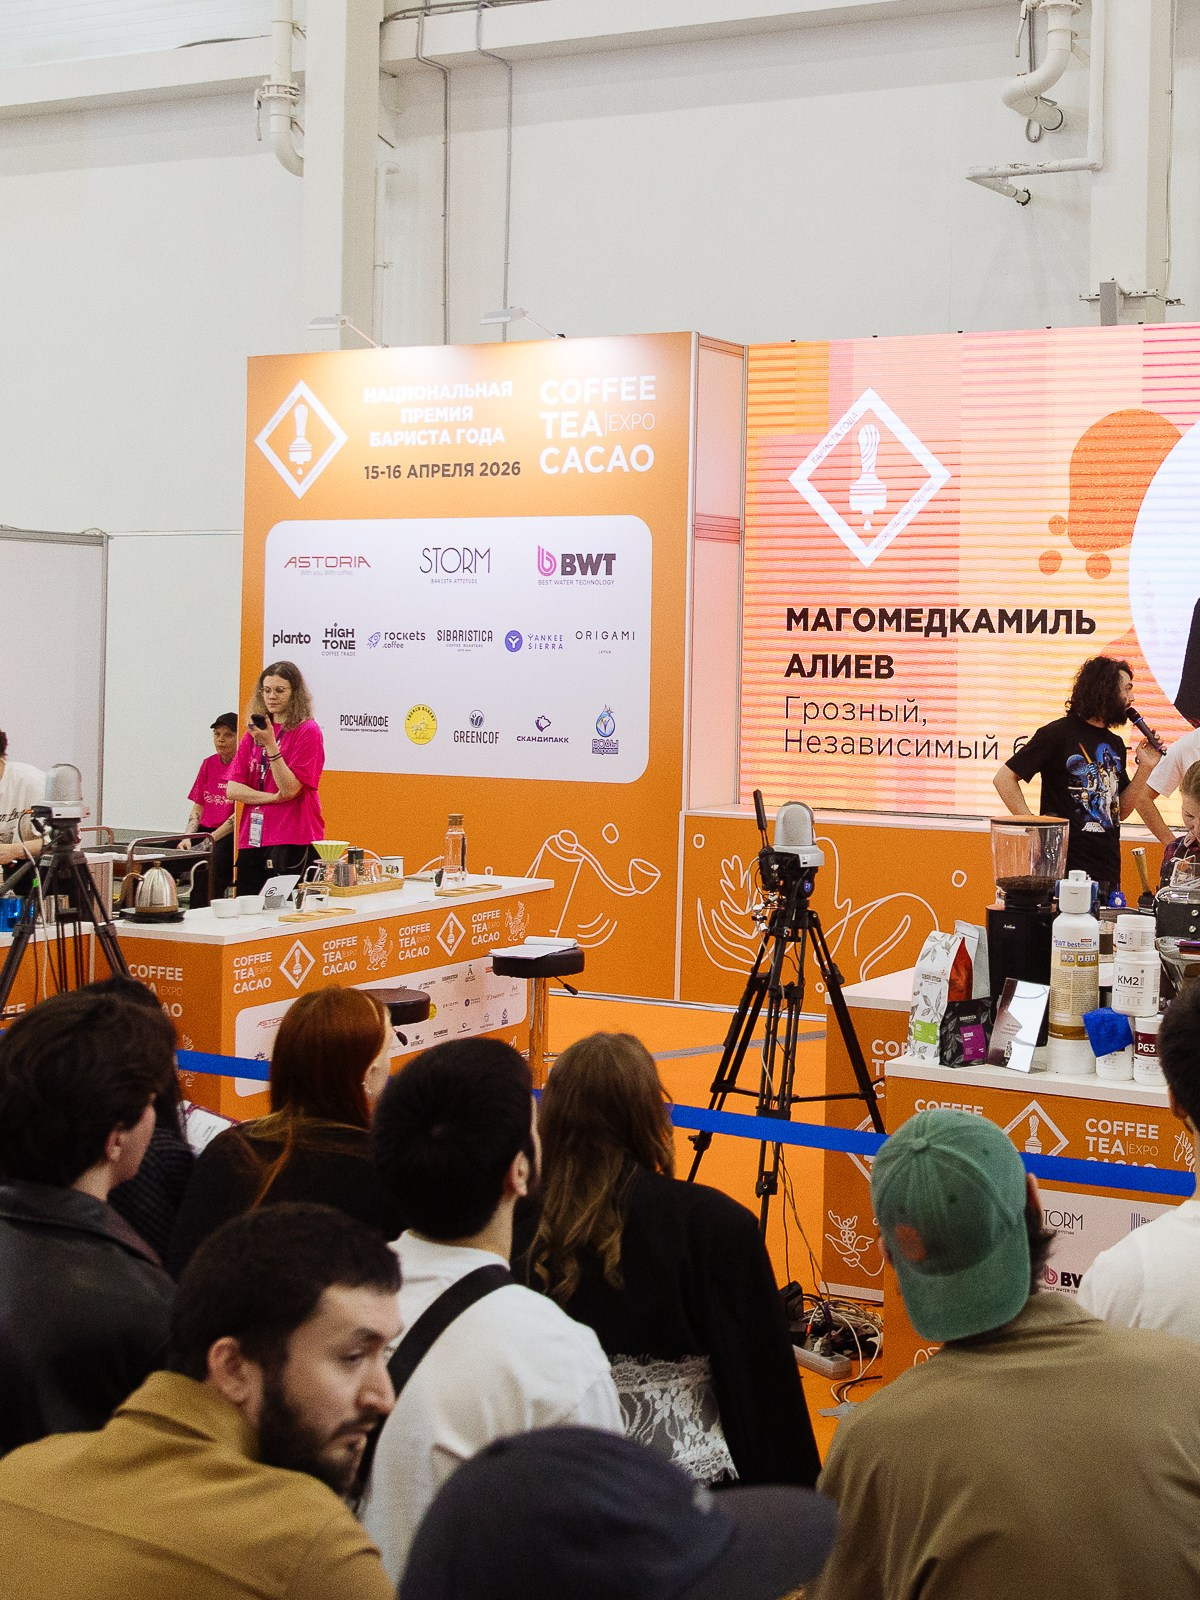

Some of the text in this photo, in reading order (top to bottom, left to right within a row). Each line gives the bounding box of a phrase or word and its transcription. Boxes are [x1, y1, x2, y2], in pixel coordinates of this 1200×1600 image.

[364, 381, 513, 403] НАЦИОНАЛЬНАЯ
[540, 376, 656, 405] COFFEE
[402, 406, 474, 423] ПРЕМИЯ
[540, 411, 656, 439] TEA EXPO
[369, 427, 505, 447] БАРИСТА ГОДА
[539, 444, 656, 475] CACAO
[364, 461, 521, 480] 15-16 АПРЕЛЯ 2026
[284, 556, 372, 569] ASTORIA
[419, 547, 491, 574] STORM
[561, 553, 616, 576] BWT
[786, 607, 1097, 637] МАГОМЕДКАМИЛЬ
[272, 629, 312, 647] planto
[384, 631, 426, 641] rockets
[436, 629, 493, 642] SIBARISTICA
[528, 633, 563, 642] YANKEE
[575, 631, 636, 641] ORIGAMI
[322, 640, 356, 650] TONE
[528, 642, 564, 650] SIERRA
[784, 654, 896, 679] АЛИЕВ
[785, 696, 928, 727] Грозный,
[340, 713, 389, 727] РОСЧАЙКОФЕ
[453, 730, 500, 744] GREENCOF
[516, 735, 569, 744] СКАНДИПАКК
[785, 728, 999, 760] Независимый
[472, 909, 501, 922] COFFEE
[399, 922, 431, 937] COFFEE
[472, 923, 488, 934] TEA
[323, 936, 358, 951] COFFEE
[399, 936, 417, 948] TEA
[471, 931, 500, 945] CACAO
[233, 951, 272, 968] COFFEE
[323, 951, 342, 963] TEA
[398, 945, 430, 960] CACAO
[128, 964, 183, 981] COFFEE
[233, 968, 256, 981] TEA
[322, 960, 357, 976] CACAO
[233, 977, 272, 995] CACAO
[1118, 975, 1139, 986] KM2
[1137, 1043, 1156, 1053] P63
[1085, 1118, 1159, 1140] COFFEE
[1085, 1135, 1159, 1157] TEA EXPO
[1043, 1209, 1084, 1230] TORM
